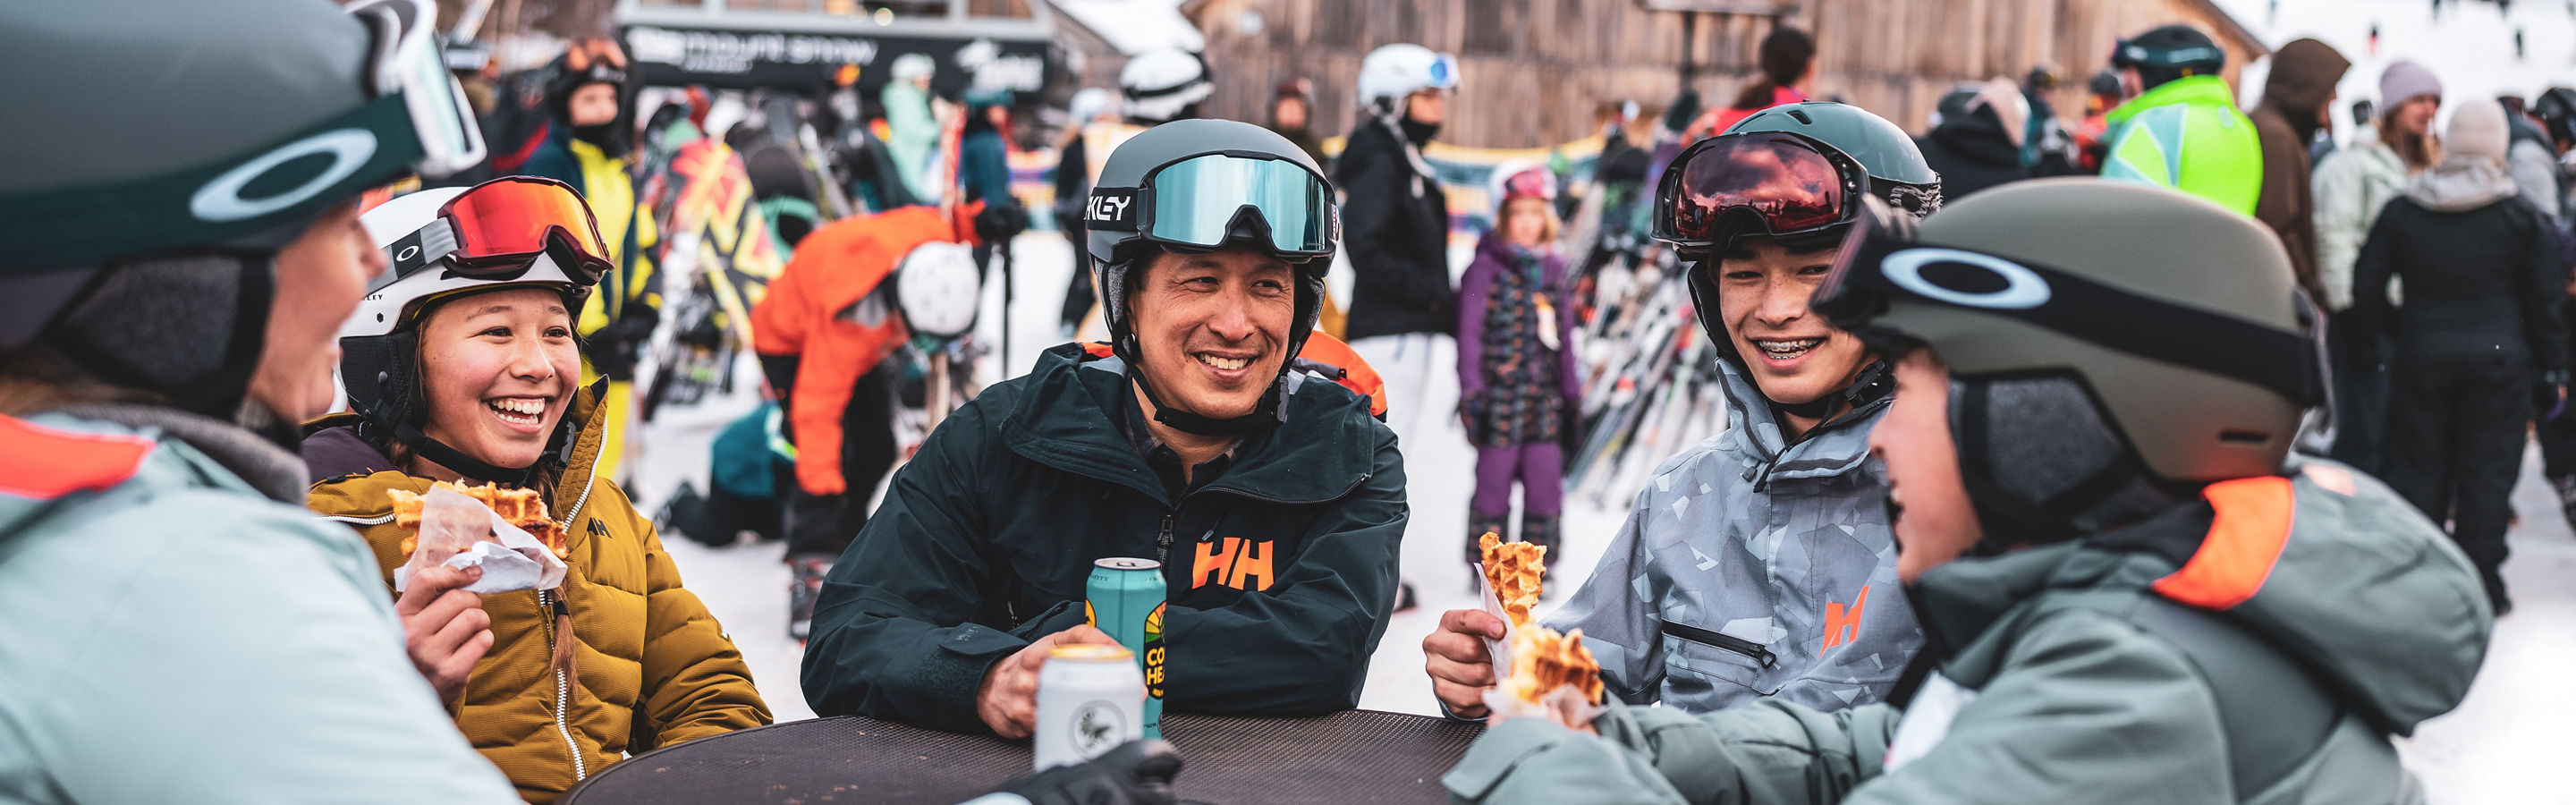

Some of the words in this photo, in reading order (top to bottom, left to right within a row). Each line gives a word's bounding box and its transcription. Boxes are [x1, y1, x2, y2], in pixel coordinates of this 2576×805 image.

[1082, 196, 1131, 221] KLEY
[1191, 537, 1275, 592] HH
[1146, 665, 1165, 686] HE
